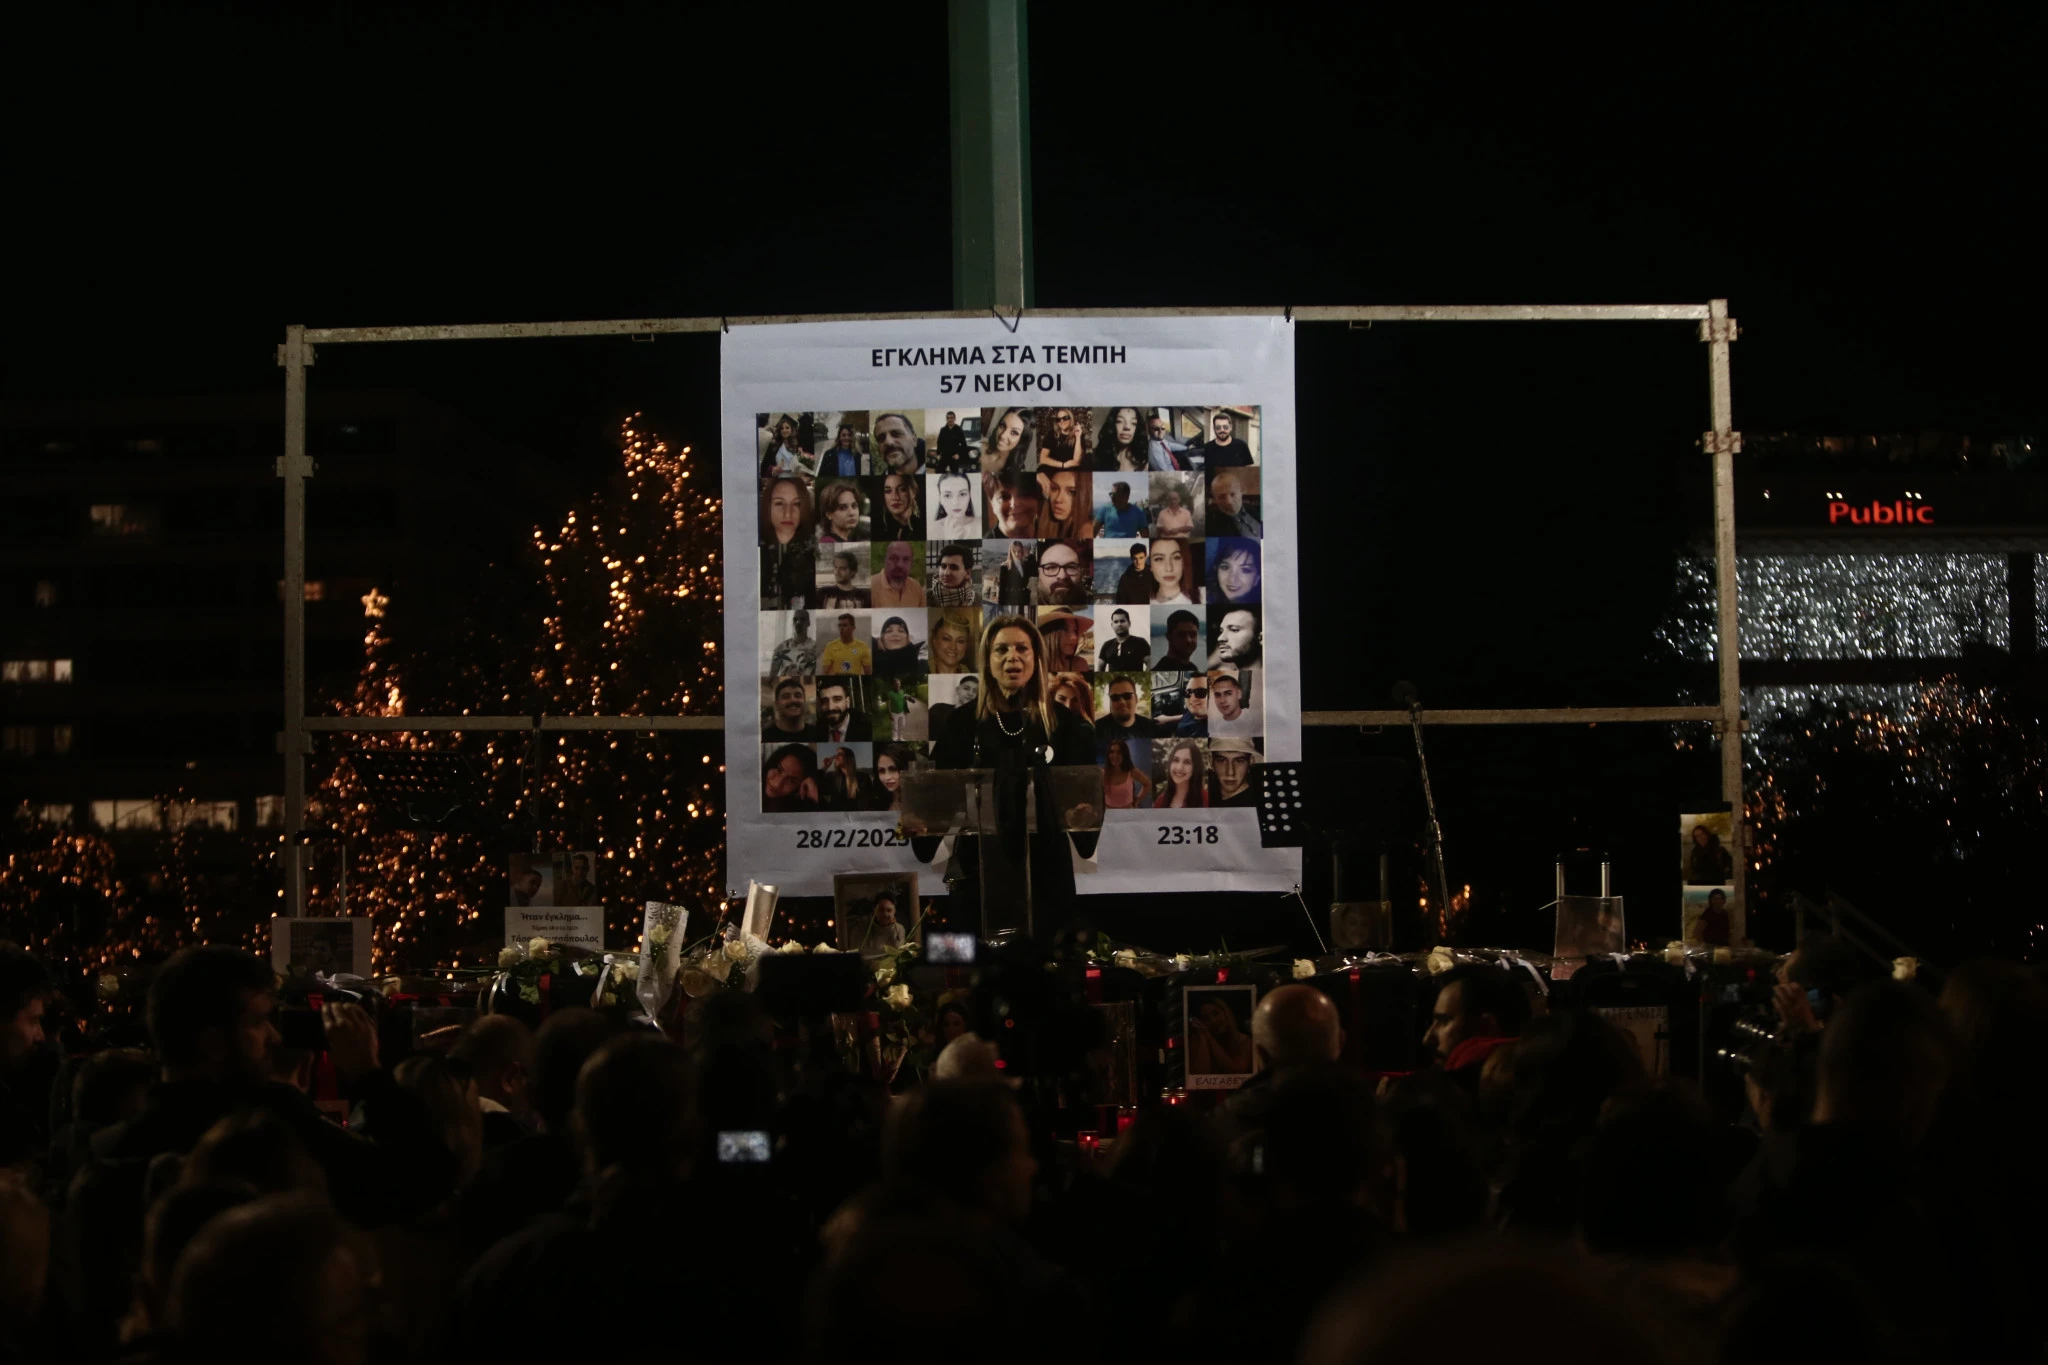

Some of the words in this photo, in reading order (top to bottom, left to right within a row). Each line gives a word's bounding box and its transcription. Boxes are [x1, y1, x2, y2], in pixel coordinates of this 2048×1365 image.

[872, 346, 985, 367] ΕΓΚΛΗΜΑ
[992, 345, 1036, 364] ΣΤΑ
[1042, 345, 1126, 364] ΤΕΜΠΗ
[940, 375, 967, 394] 57
[974, 373, 1062, 393] ΝΕΚΡΟΙ
[1828, 499, 1935, 525] Public
[1157, 825, 1219, 845] 23:18
